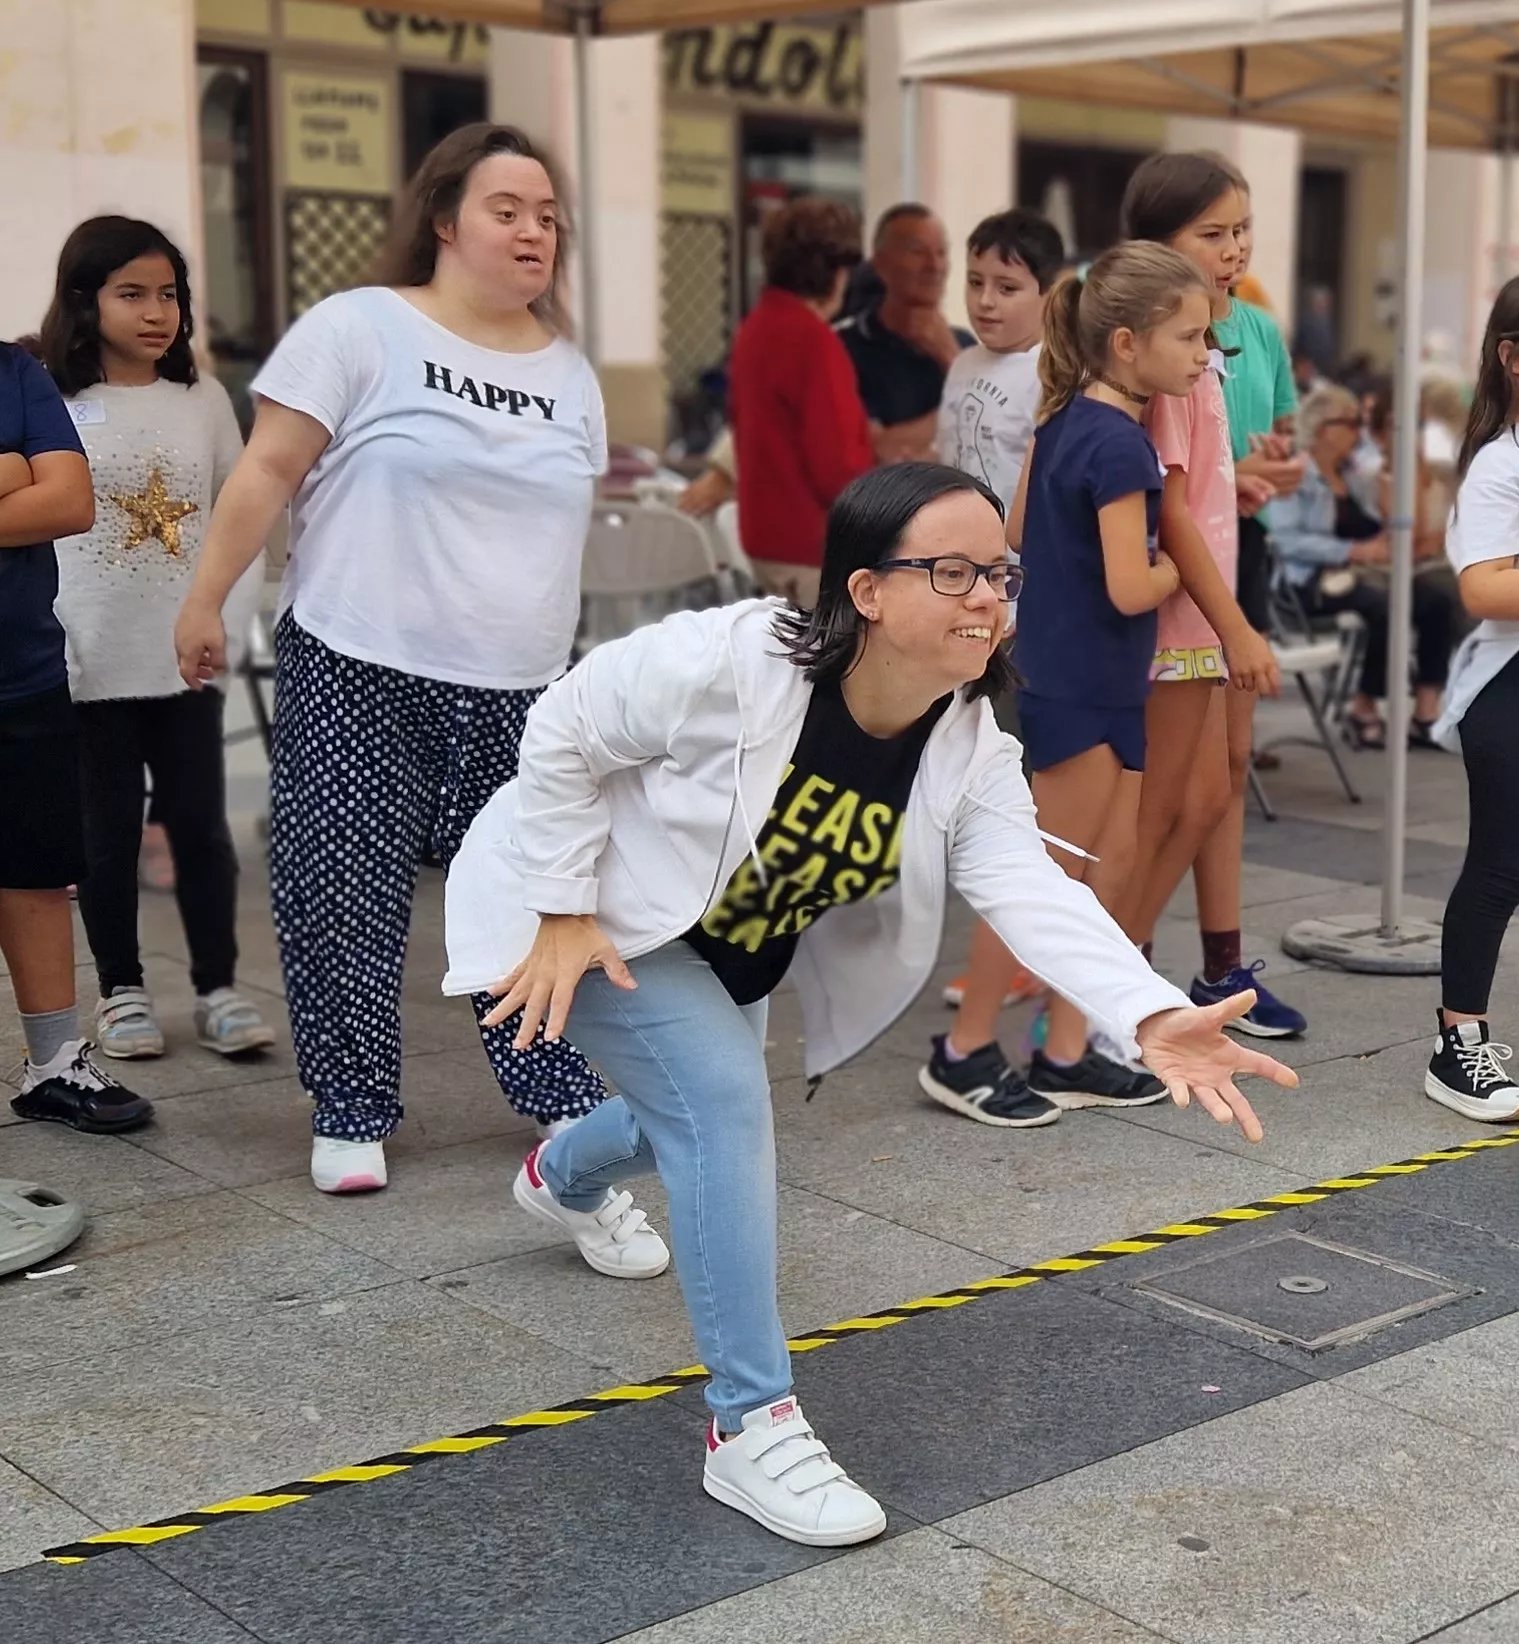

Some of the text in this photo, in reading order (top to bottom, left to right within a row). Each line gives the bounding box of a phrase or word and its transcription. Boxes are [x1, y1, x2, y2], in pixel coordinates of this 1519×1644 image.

[663, 19, 864, 106] ndol
[423, 360, 556, 421] HAPPY
[970, 377, 1009, 407] ORNIA
[768, 763, 904, 871] EAS
